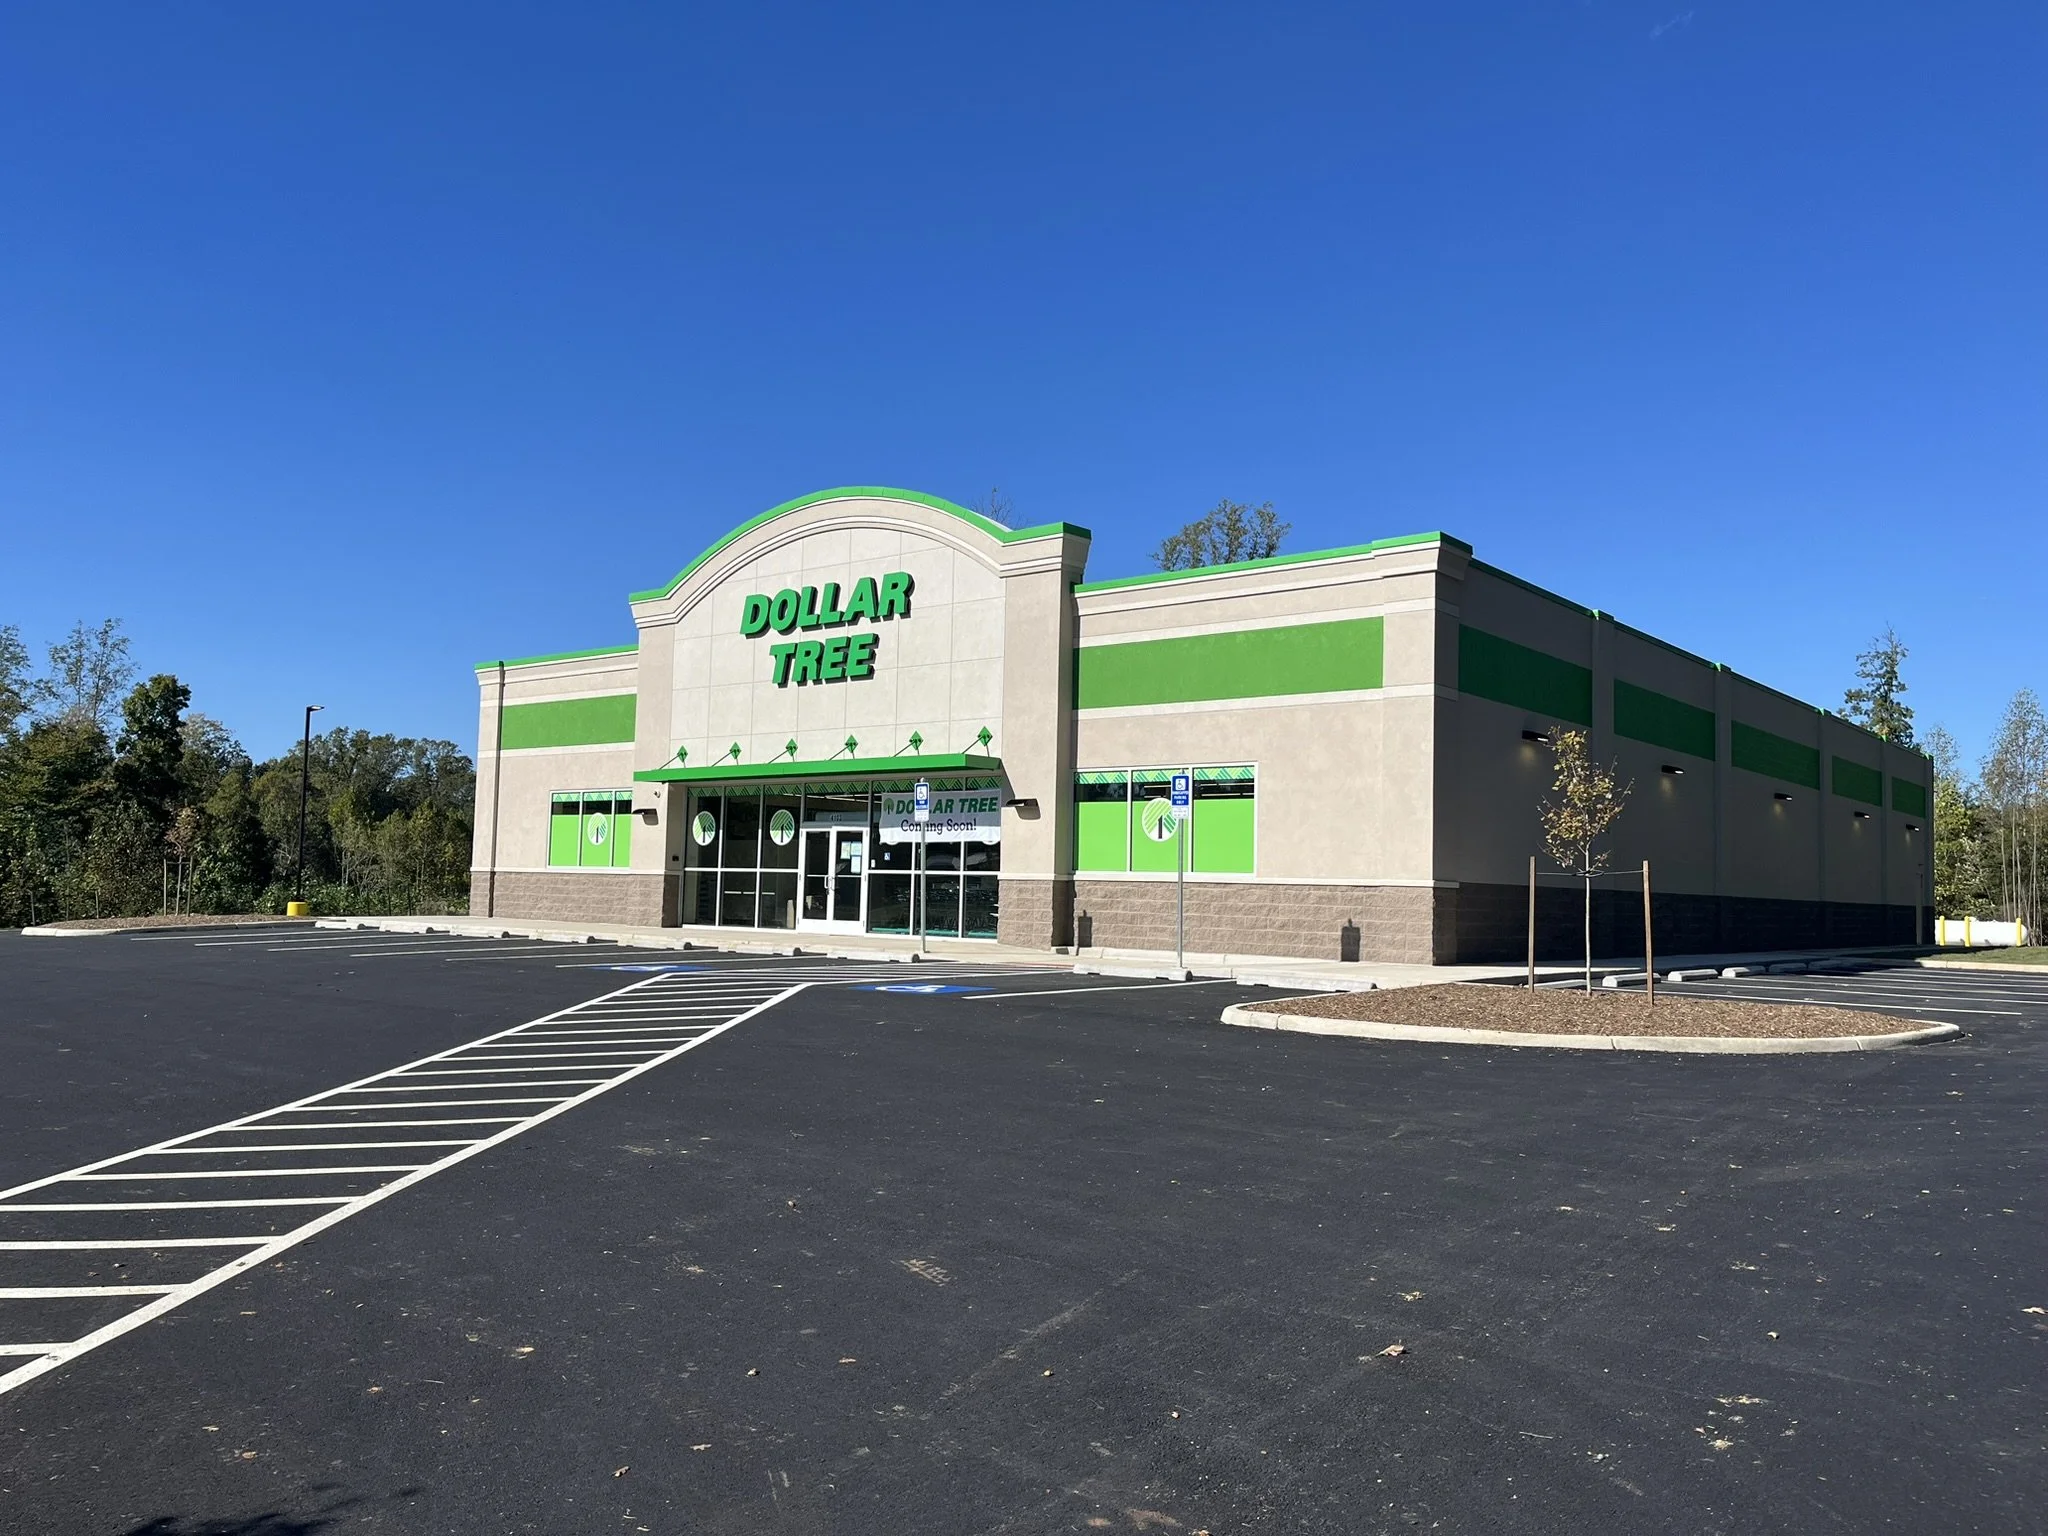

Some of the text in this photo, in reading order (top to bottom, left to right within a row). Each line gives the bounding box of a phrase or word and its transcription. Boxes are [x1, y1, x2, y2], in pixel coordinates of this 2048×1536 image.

[740, 572, 915, 639] DOLLAR
[769, 633, 880, 688] TREE
[896, 797, 999, 815] DOAR TREE
[946, 817, 977, 832] Soon!
